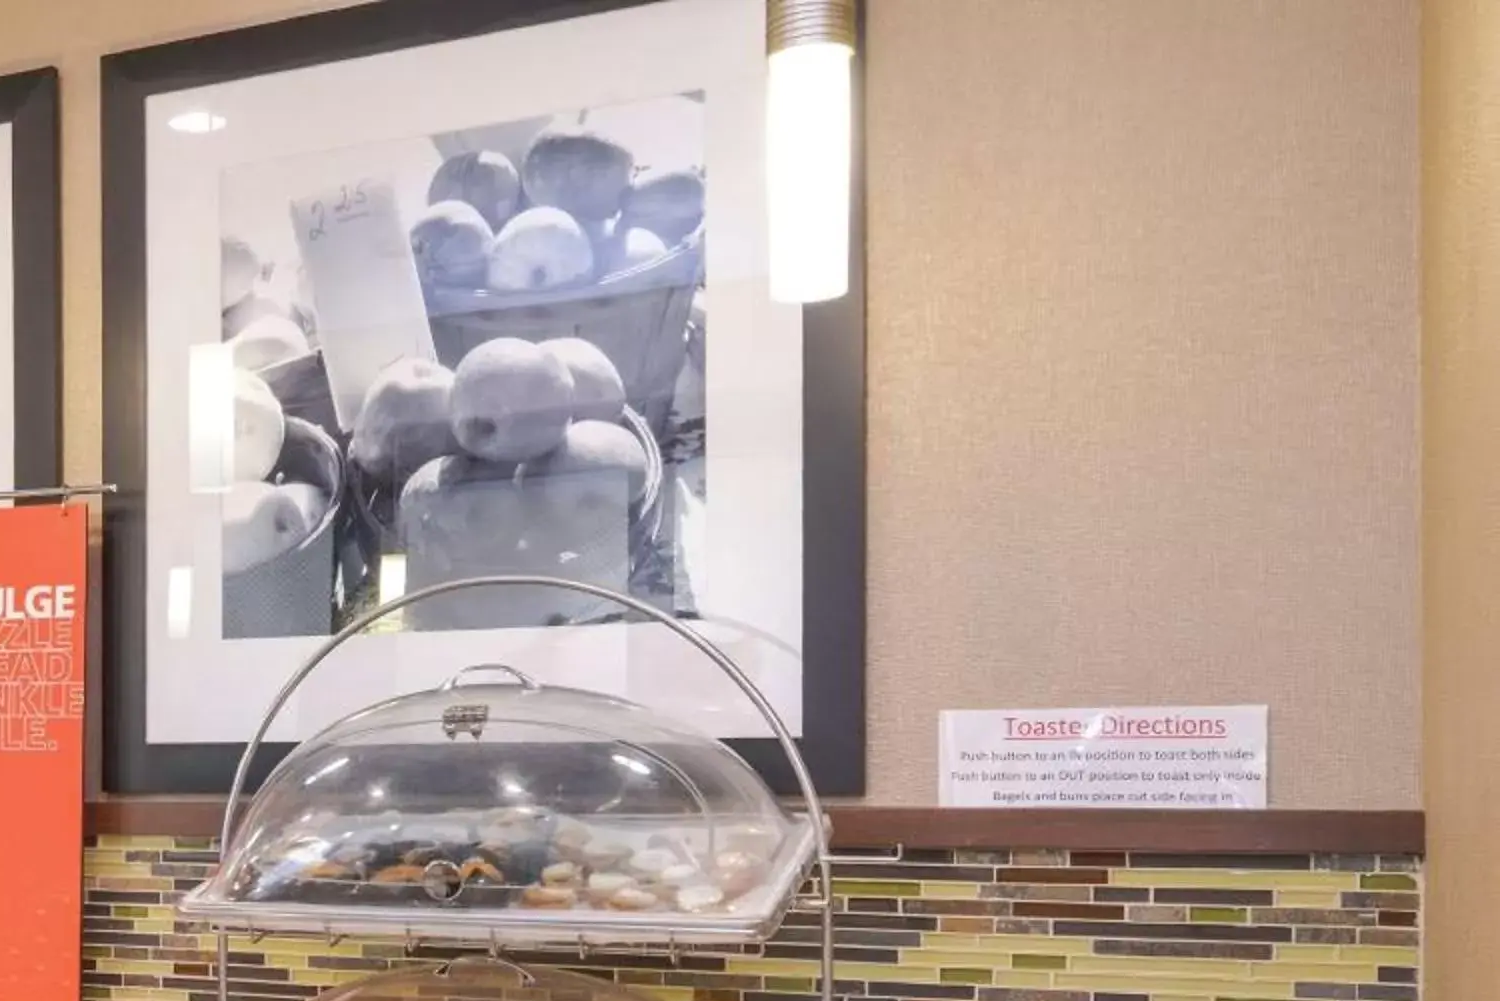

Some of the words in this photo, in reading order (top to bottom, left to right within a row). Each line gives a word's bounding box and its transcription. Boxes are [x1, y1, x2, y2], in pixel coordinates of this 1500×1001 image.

[1102, 715, 1226, 735] Directions
[991, 750, 1032, 761] button
[1085, 750, 1135, 763] position
[1139, 750, 1151, 760] to
[1155, 750, 1187, 760] toast
[1190, 748, 1220, 760] both
[1223, 748, 1255, 760] sides
[981, 770, 1021, 781] button
[1058, 771, 1085, 781] OUT
[1157, 770, 1190, 781] toast
[1033, 790, 1056, 801] and
